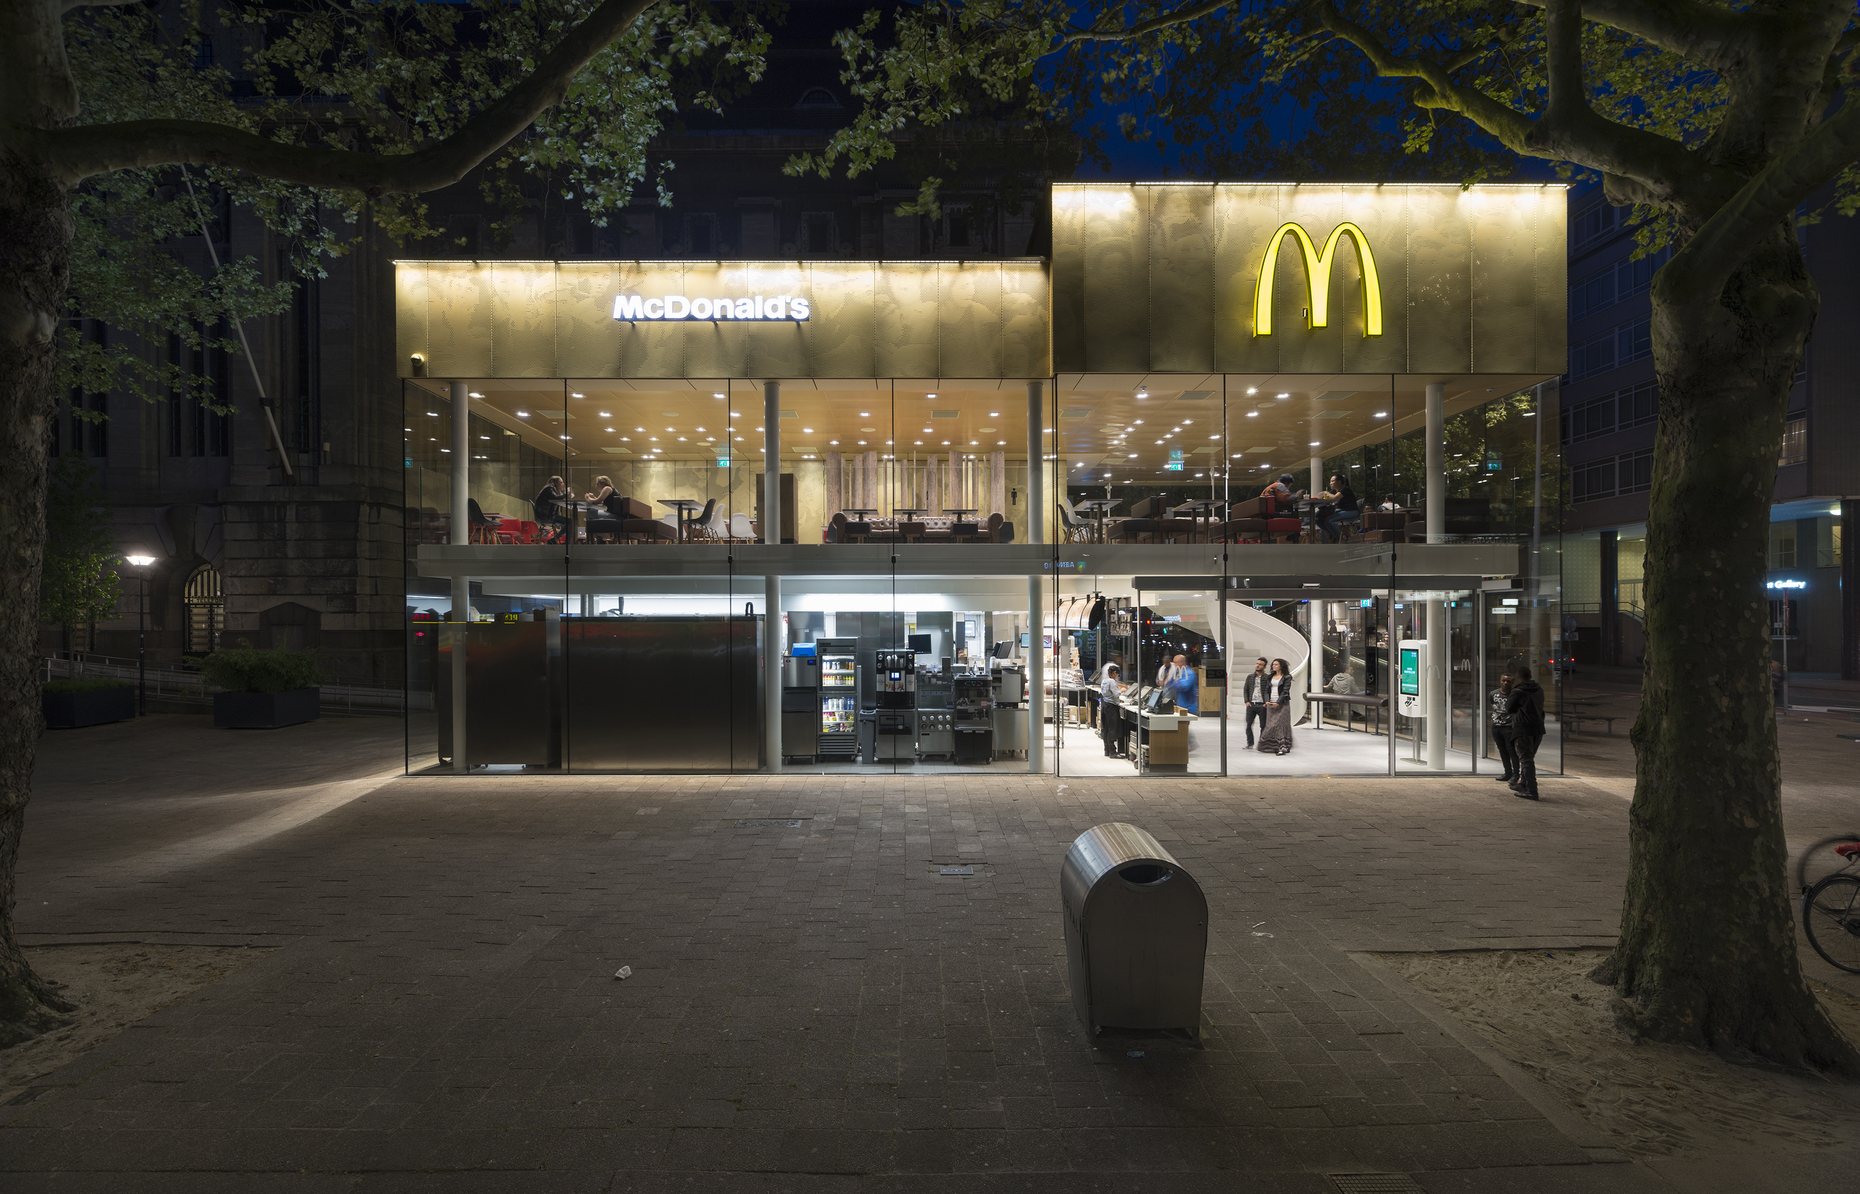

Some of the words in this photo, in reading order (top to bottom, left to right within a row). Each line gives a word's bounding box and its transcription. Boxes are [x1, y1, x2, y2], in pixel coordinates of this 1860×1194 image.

[1253, 222, 1383, 336] M
[613, 295, 810, 320] McDonald's
[1774, 579, 1806, 589] Gallery
